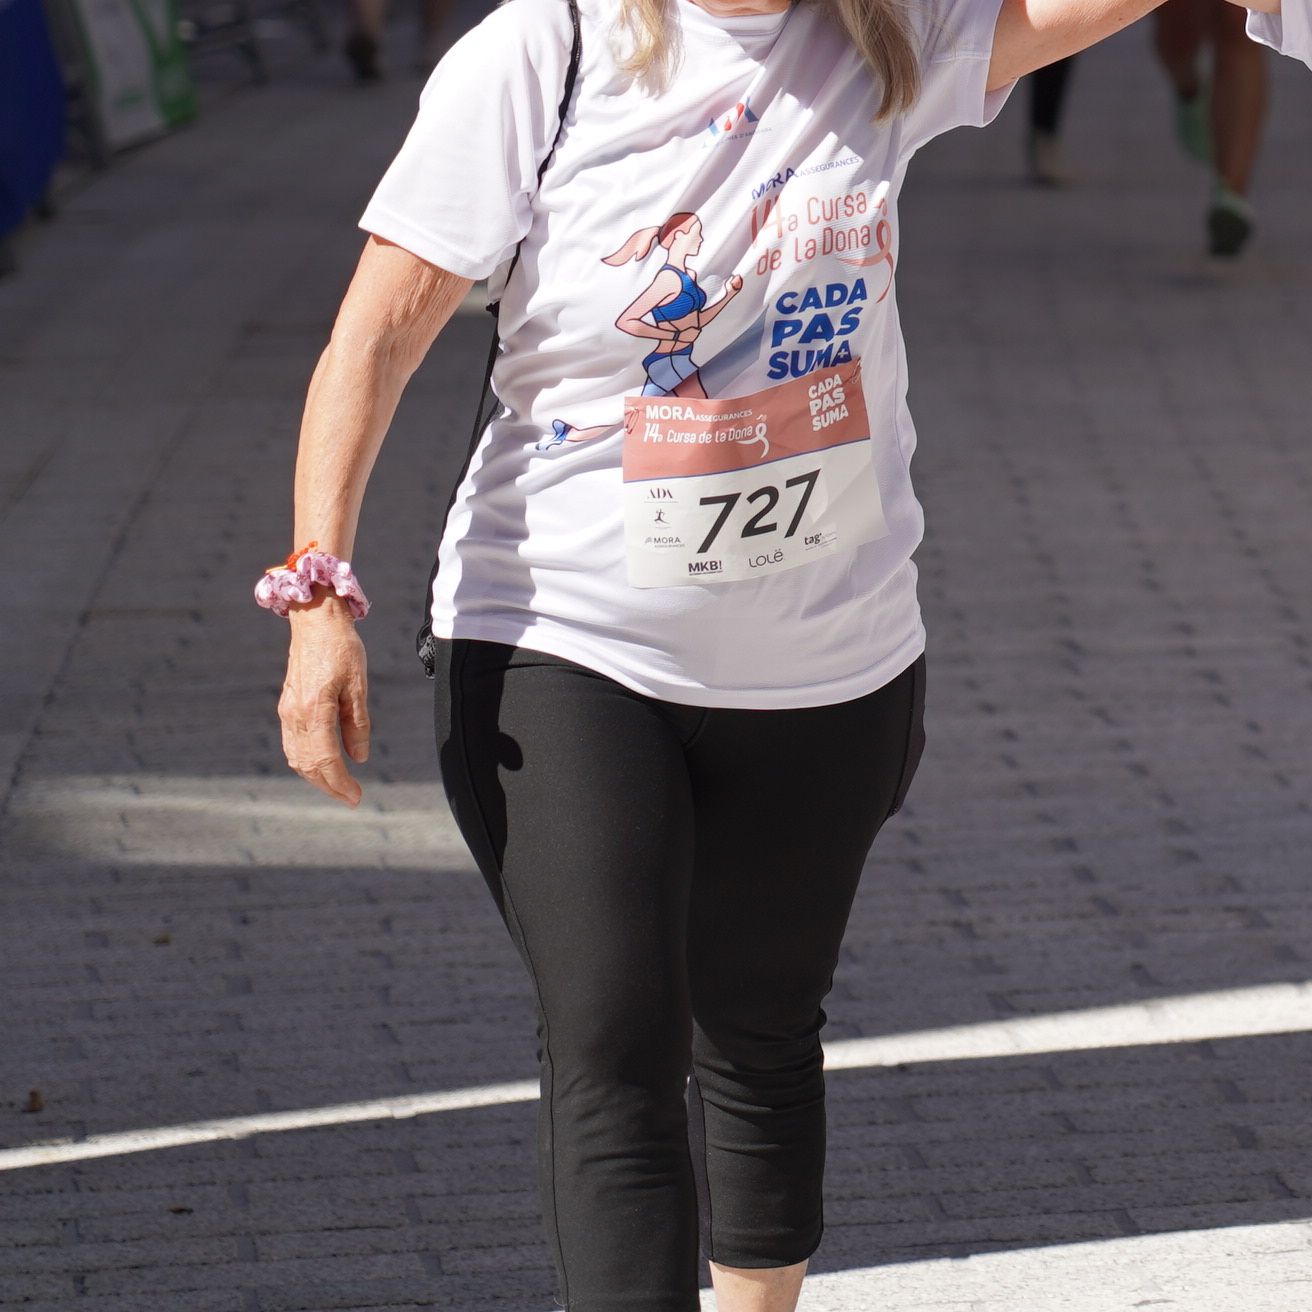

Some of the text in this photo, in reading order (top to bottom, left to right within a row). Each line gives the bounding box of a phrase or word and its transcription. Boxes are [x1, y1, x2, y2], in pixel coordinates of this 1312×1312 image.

[800, 156, 860, 177] ASSEGURANCES
[807, 192, 867, 225] Cursa
[756, 225, 870, 276] de la Dona
[775, 277, 867, 315] CADA
[771, 307, 863, 348] PAS
[767, 340, 853, 380] SUMA
[808, 374, 843, 399] CADA
[646, 405, 753, 422] MORA ASSEGURANCES
[809, 388, 846, 417] PAS
[812, 406, 848, 432] SUMA
[667, 429, 697, 443] Cursa
[698, 431, 712, 444] de
[715, 431, 726, 443] la
[727, 425, 753, 441] Dona
[696, 469, 821, 554] 727
[654, 536, 681, 544] MORA
